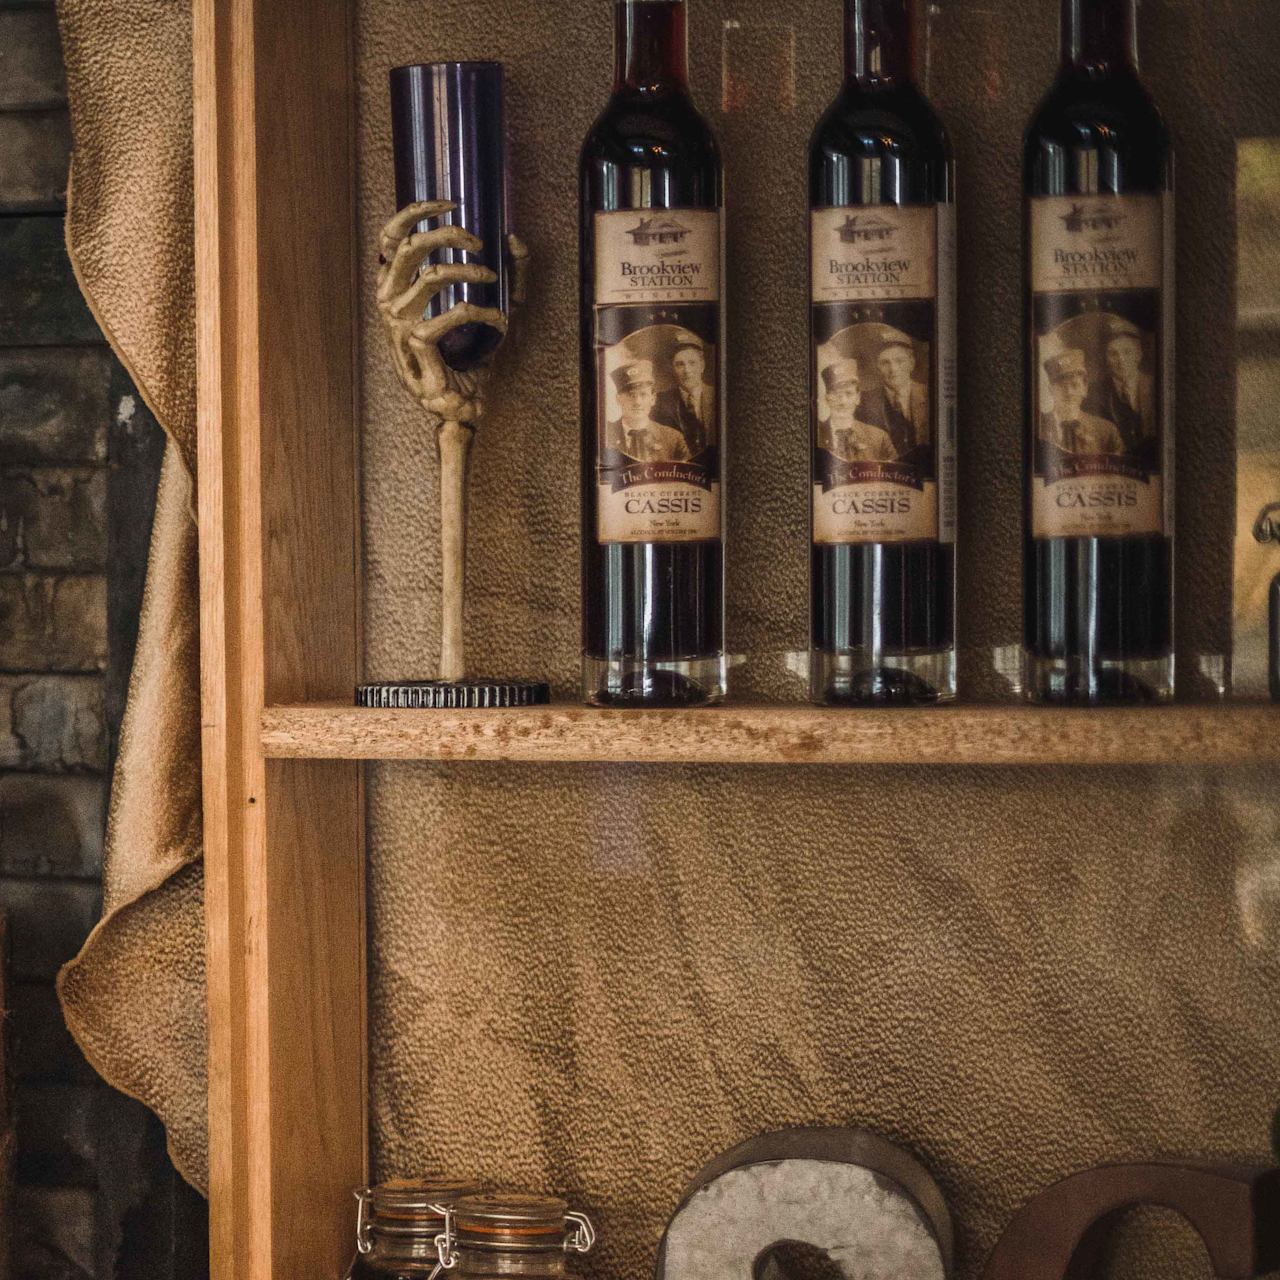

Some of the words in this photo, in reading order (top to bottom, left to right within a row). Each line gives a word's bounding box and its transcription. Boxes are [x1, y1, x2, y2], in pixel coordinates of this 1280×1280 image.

[1054, 249, 1138, 263] Brookview
[621, 261, 701, 276] Brookview
[829, 259, 911, 274] Brookview
[630, 275, 693, 286] STATION
[836, 273, 900, 285] STATION
[625, 499, 701, 513] CASSIS
[832, 499, 911, 514] CASSIS
[1056, 492, 1138, 508] CASSIS
